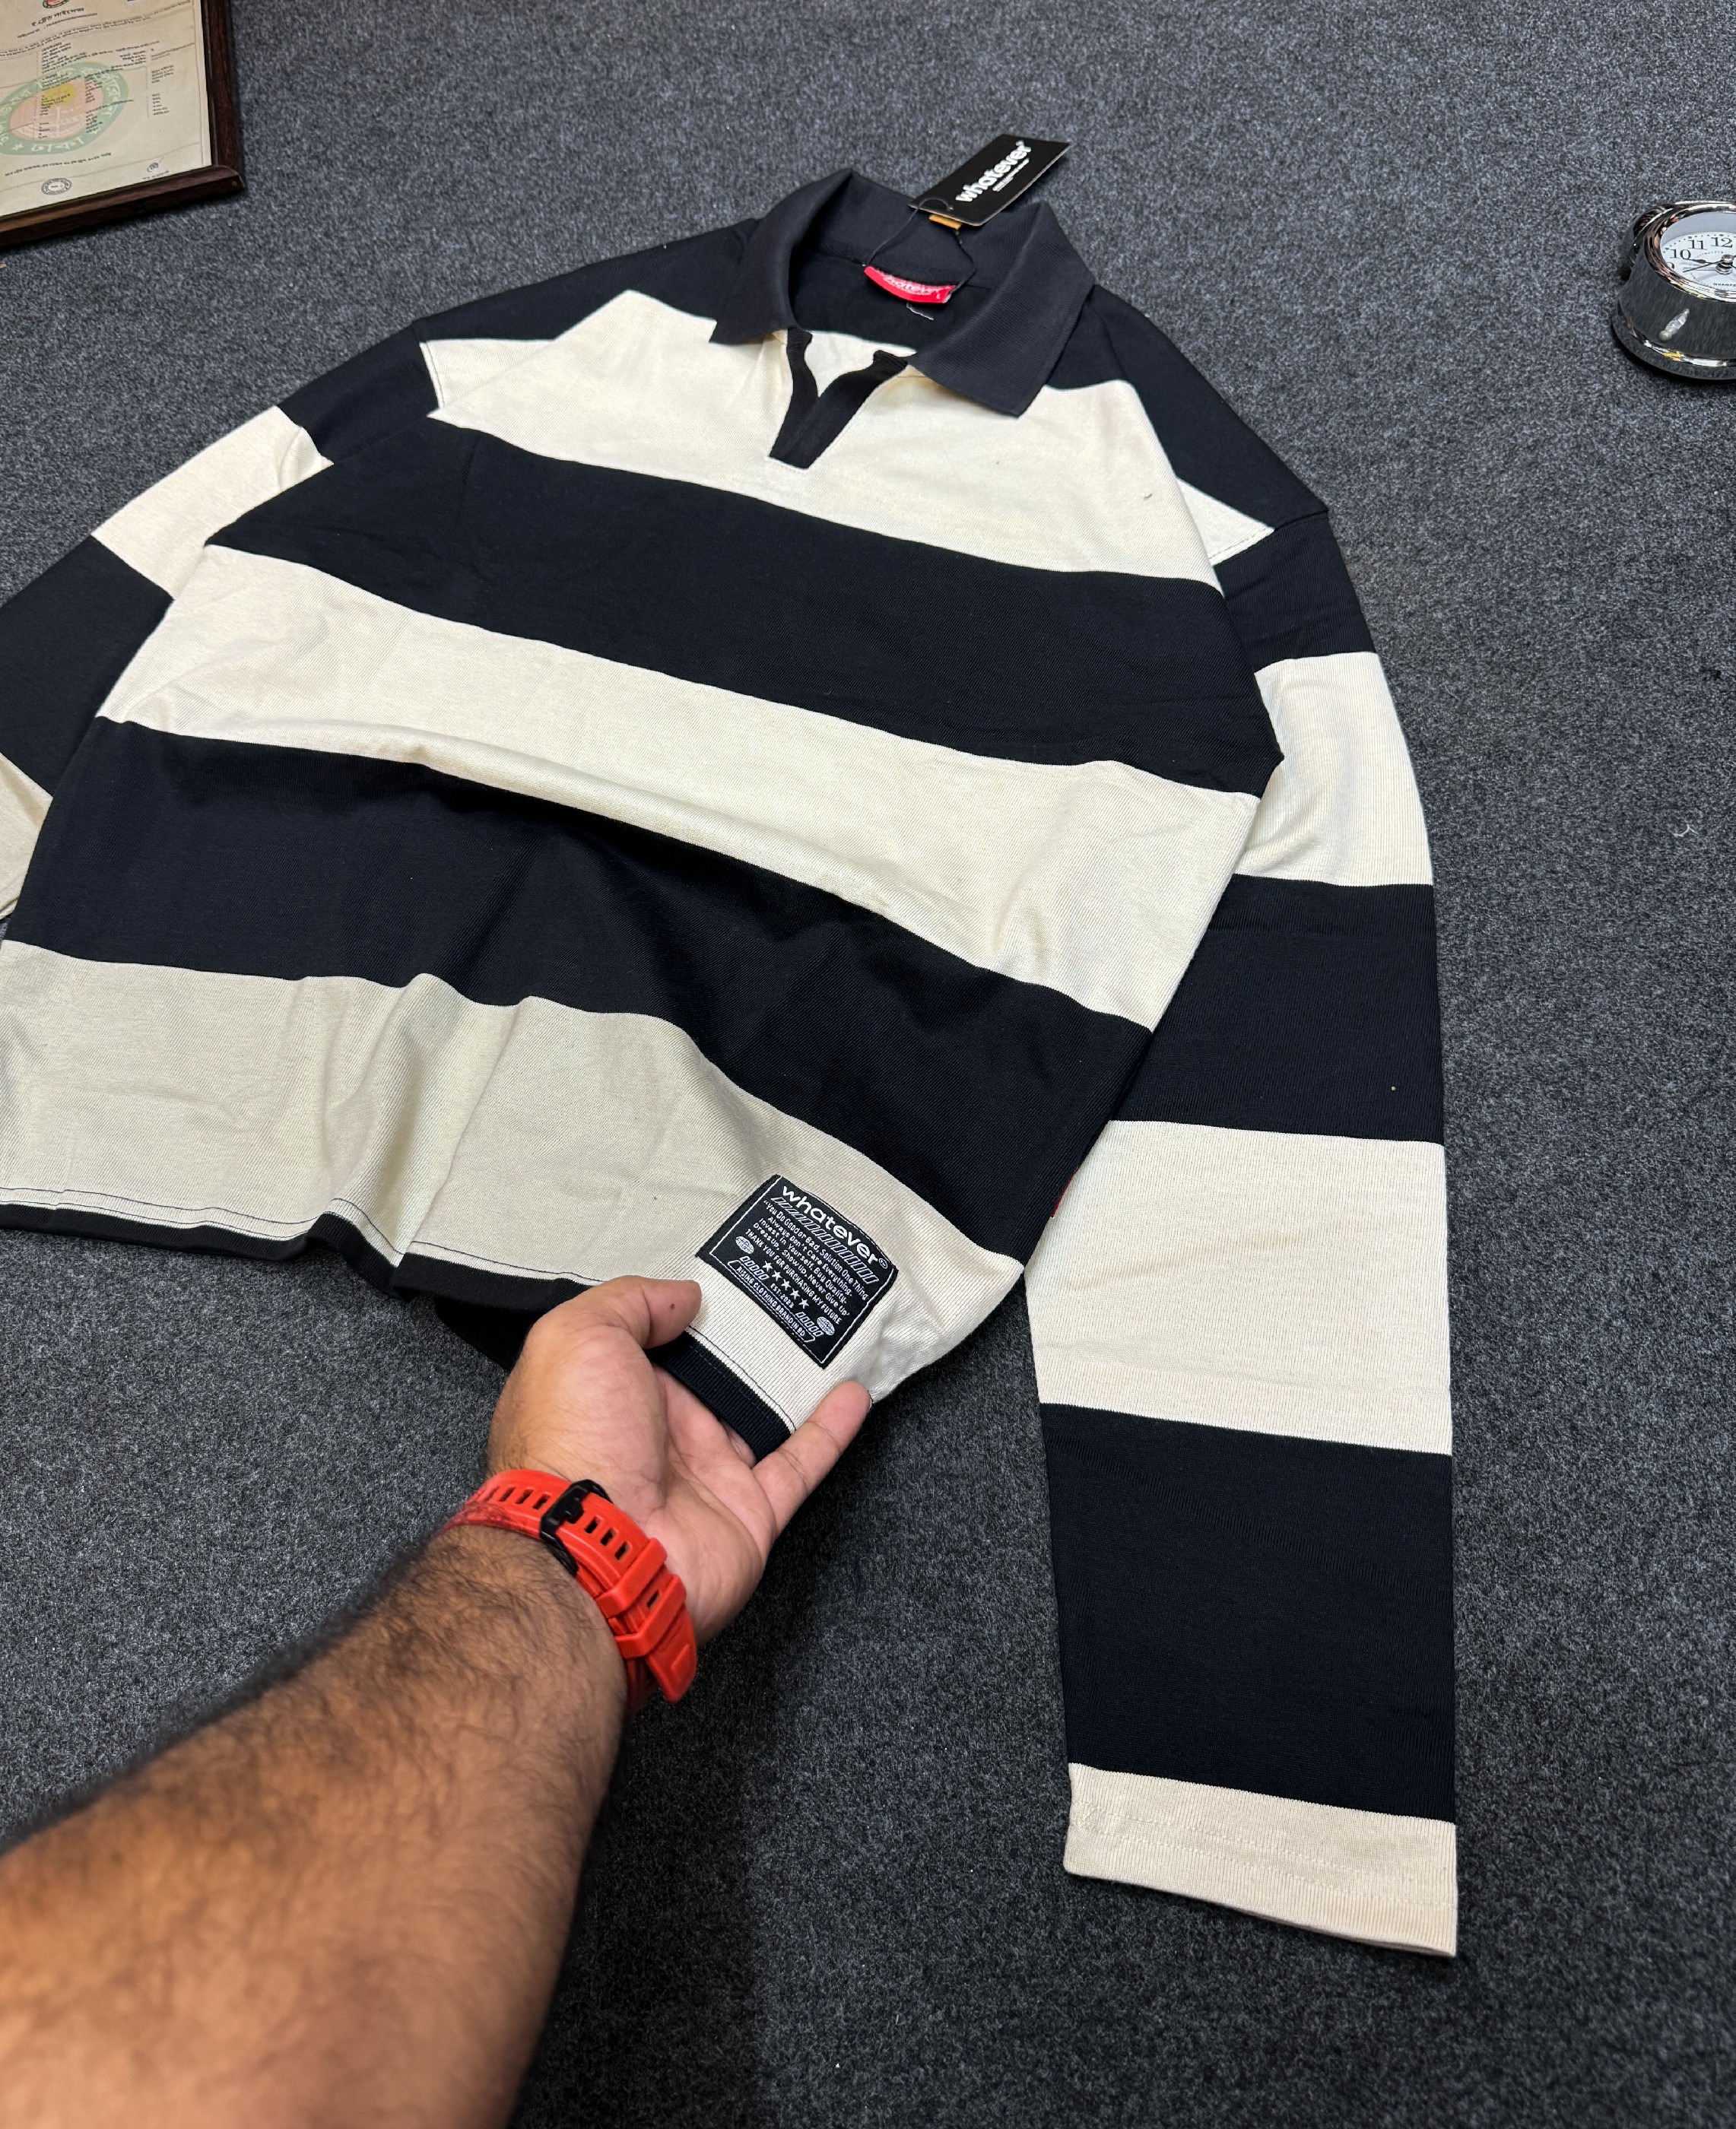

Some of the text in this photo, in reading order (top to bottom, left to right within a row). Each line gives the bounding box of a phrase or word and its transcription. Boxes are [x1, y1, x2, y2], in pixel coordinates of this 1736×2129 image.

[955, 144, 1031, 202] whatever
[1670, 249, 1691, 259] 10
[1687, 239, 1707, 250] 11
[1711, 236, 1733, 248] 12
[759, 1217, 847, 1304] Invest in Yourself. Buy Quality.
[767, 1217, 790, 1238] Always
[807, 1249, 823, 1265] Care
[822, 1263, 852, 1296] Everything.
[776, 1210, 785, 1222] Do
[820, 1249, 843, 1273] Solution
[841, 1269, 854, 1284] One
[852, 1280, 868, 1301] Thing
[782, 1185, 878, 1264] whatever
[736, 1266, 755, 1284] RISING
[753, 1282, 778, 1307] CLOTHING
[776, 1305, 794, 1324] BRAND
[745, 1228, 765, 1248] THANK
[763, 1244, 776, 1257] YOU
[773, 1255, 785, 1268] FOR
[782, 1264, 815, 1297] PURCHASING
[811, 1294, 824, 1306] MY
[820, 1303, 843, 1325] FUTURE
[753, 1222, 772, 1241] Dress
[782, 1249, 800, 1267] Show
[808, 1274, 827, 1294] Never
[825, 1292, 839, 1308] Give
